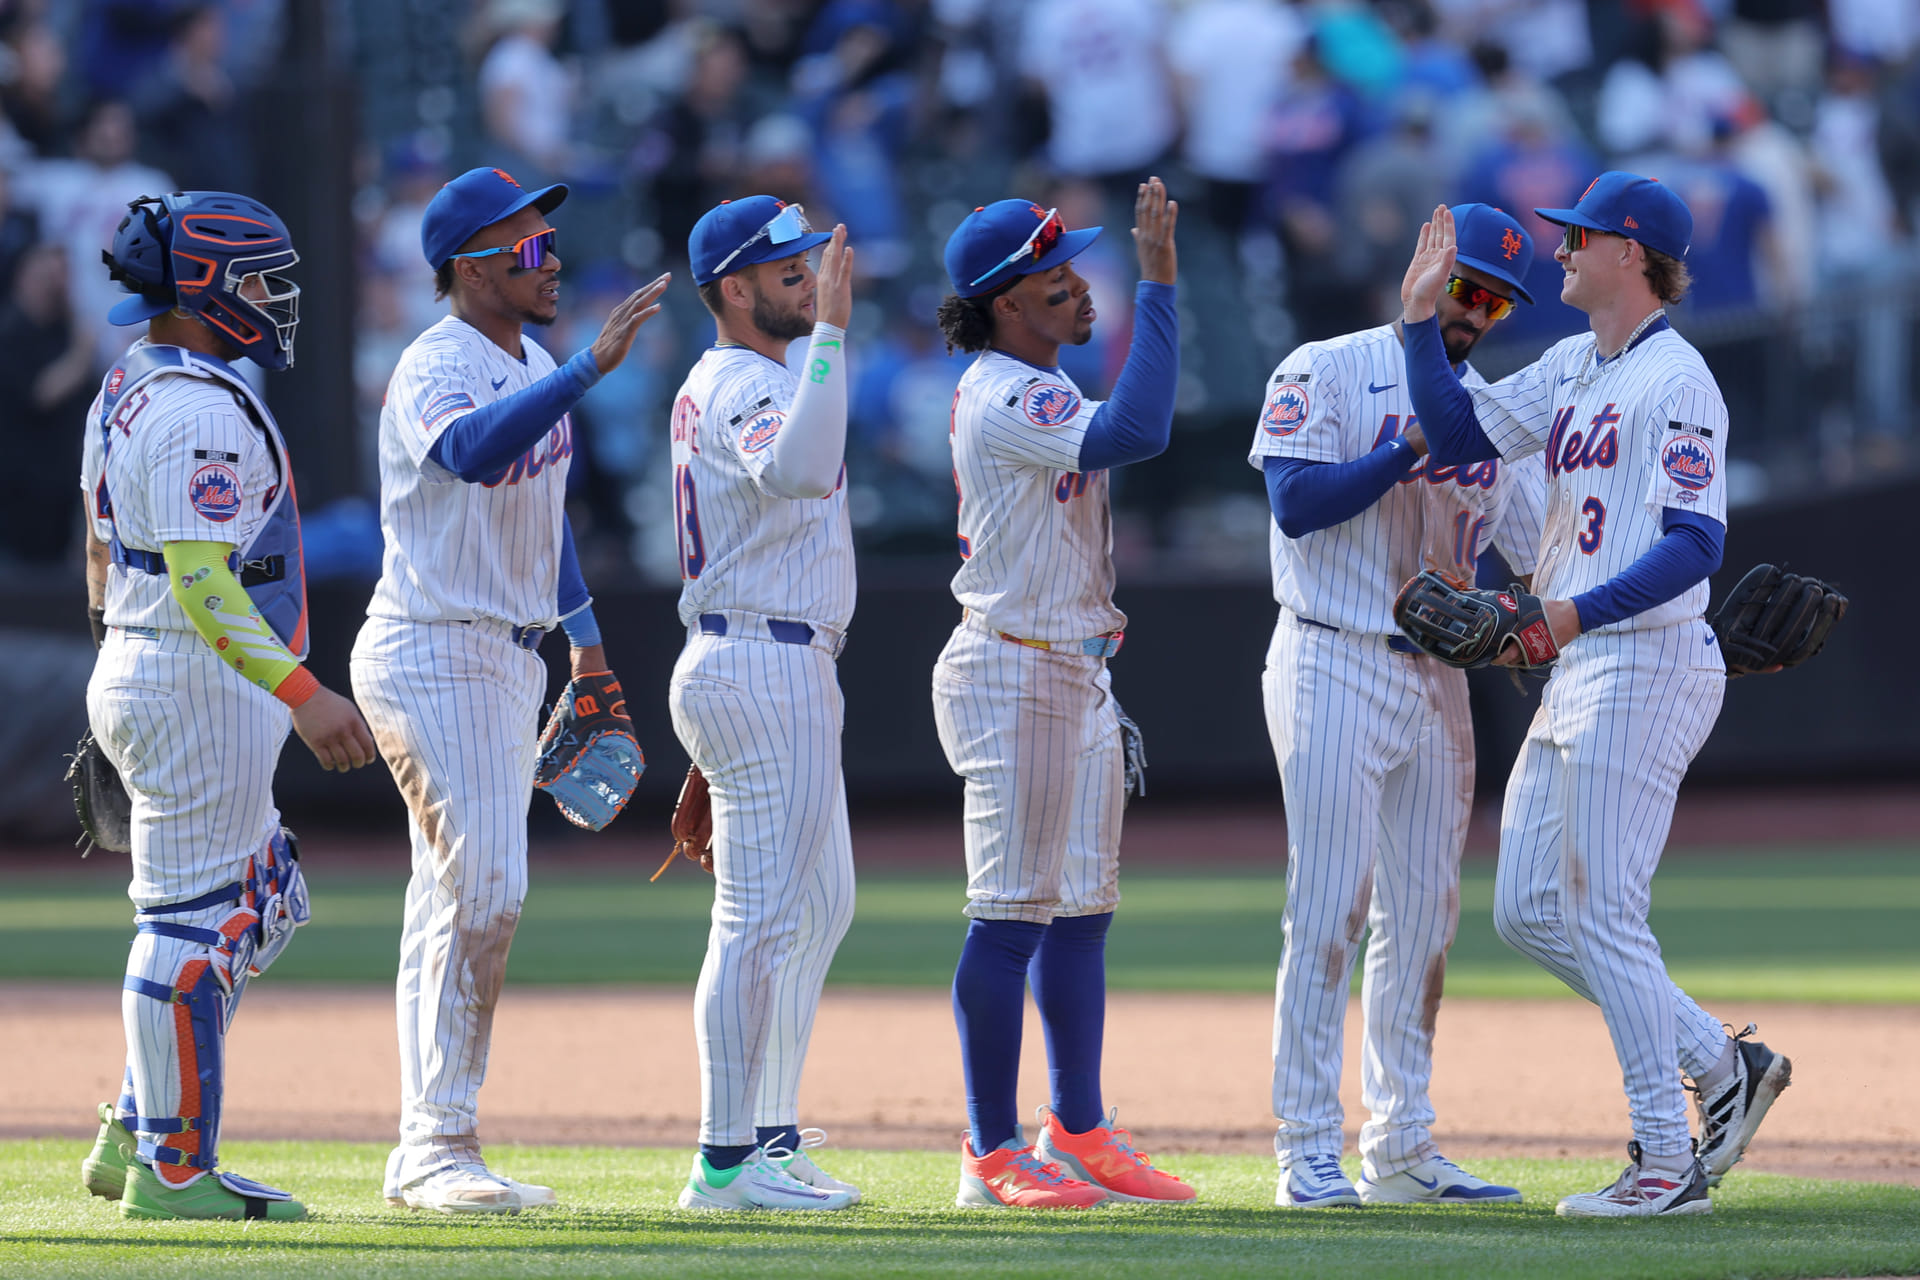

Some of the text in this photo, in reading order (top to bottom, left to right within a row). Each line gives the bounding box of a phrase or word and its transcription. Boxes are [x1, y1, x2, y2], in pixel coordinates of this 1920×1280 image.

[1266, 403, 1300, 421] Mets
[1681, 422, 1702, 435] DAVEY
[1669, 455, 1707, 477] Mets
[197, 485, 235, 506] Mets
[1578, 495, 1607, 557] 3
